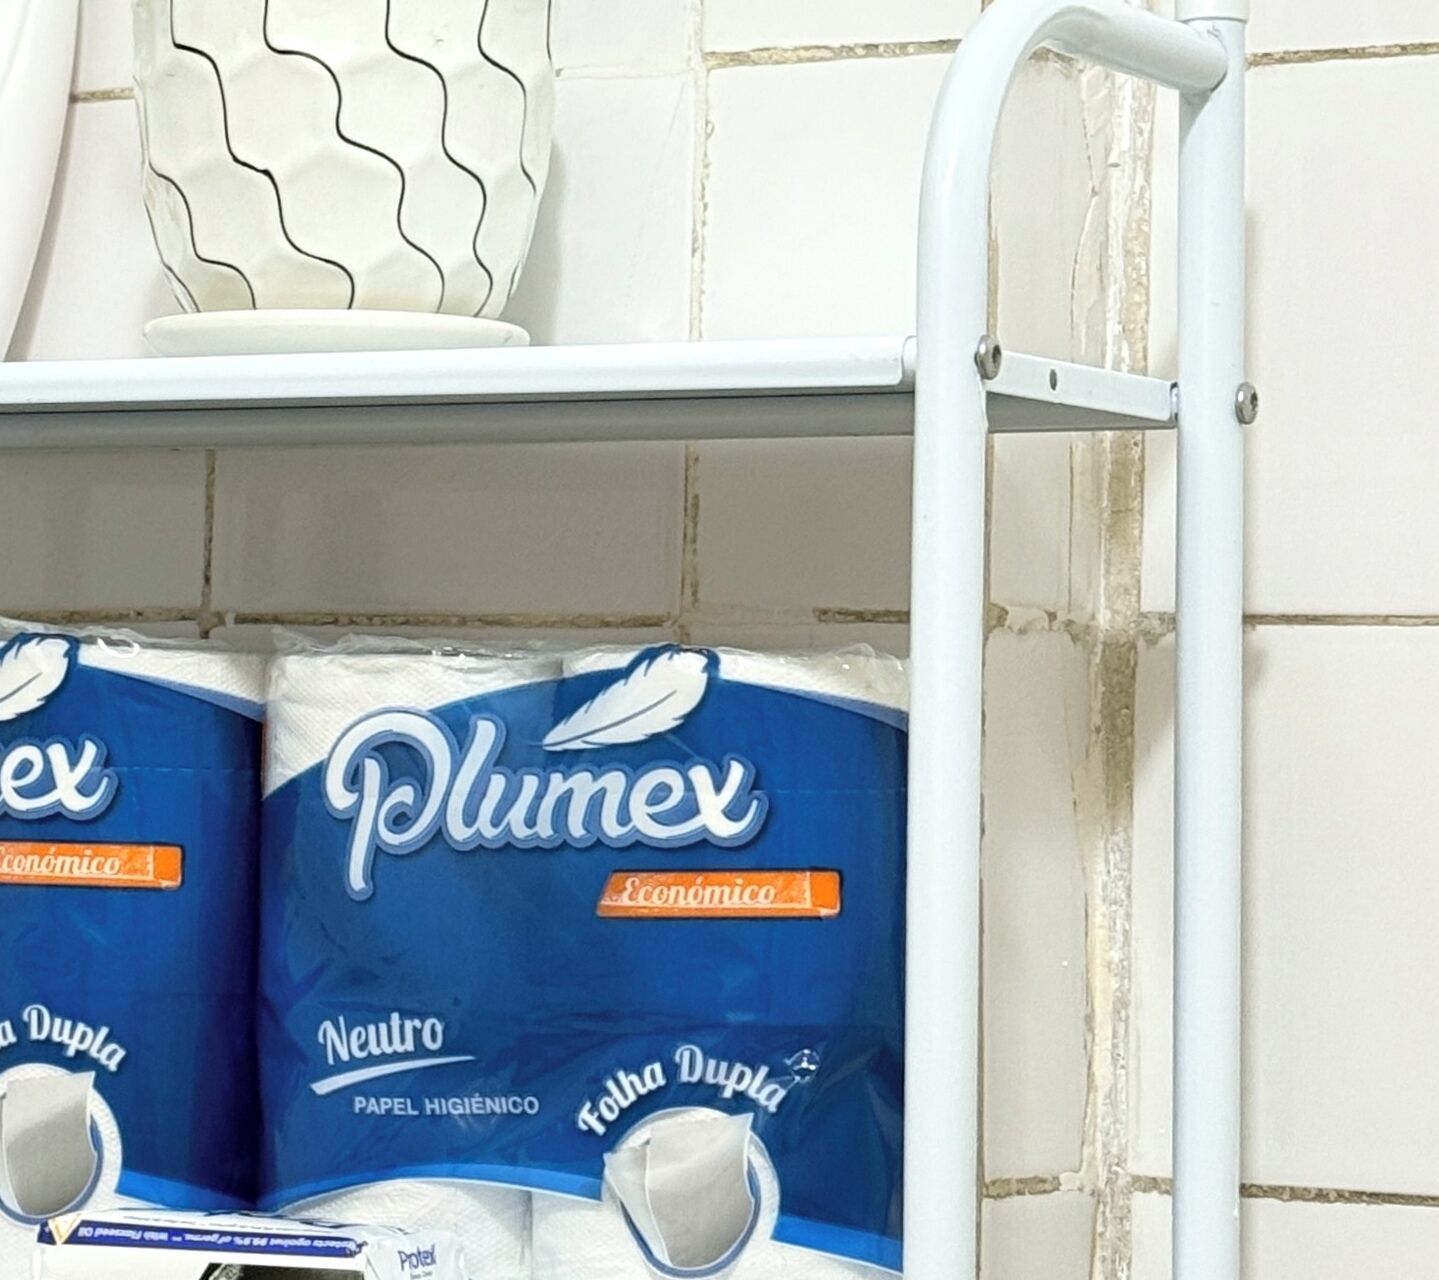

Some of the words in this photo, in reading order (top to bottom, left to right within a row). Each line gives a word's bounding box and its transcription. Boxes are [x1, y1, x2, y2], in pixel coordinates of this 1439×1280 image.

[324, 710, 765, 895] Plumex
[621, 875, 776, 905] Económico
[22, 1004, 127, 1072] Dupla
[318, 1012, 445, 1065] Neutro
[353, 1095, 415, 1115] PAPEL
[422, 1093, 540, 1116] HIGIÉNICO
[577, 1061, 667, 1136] Folha
[675, 1044, 786, 1113] Dupla
